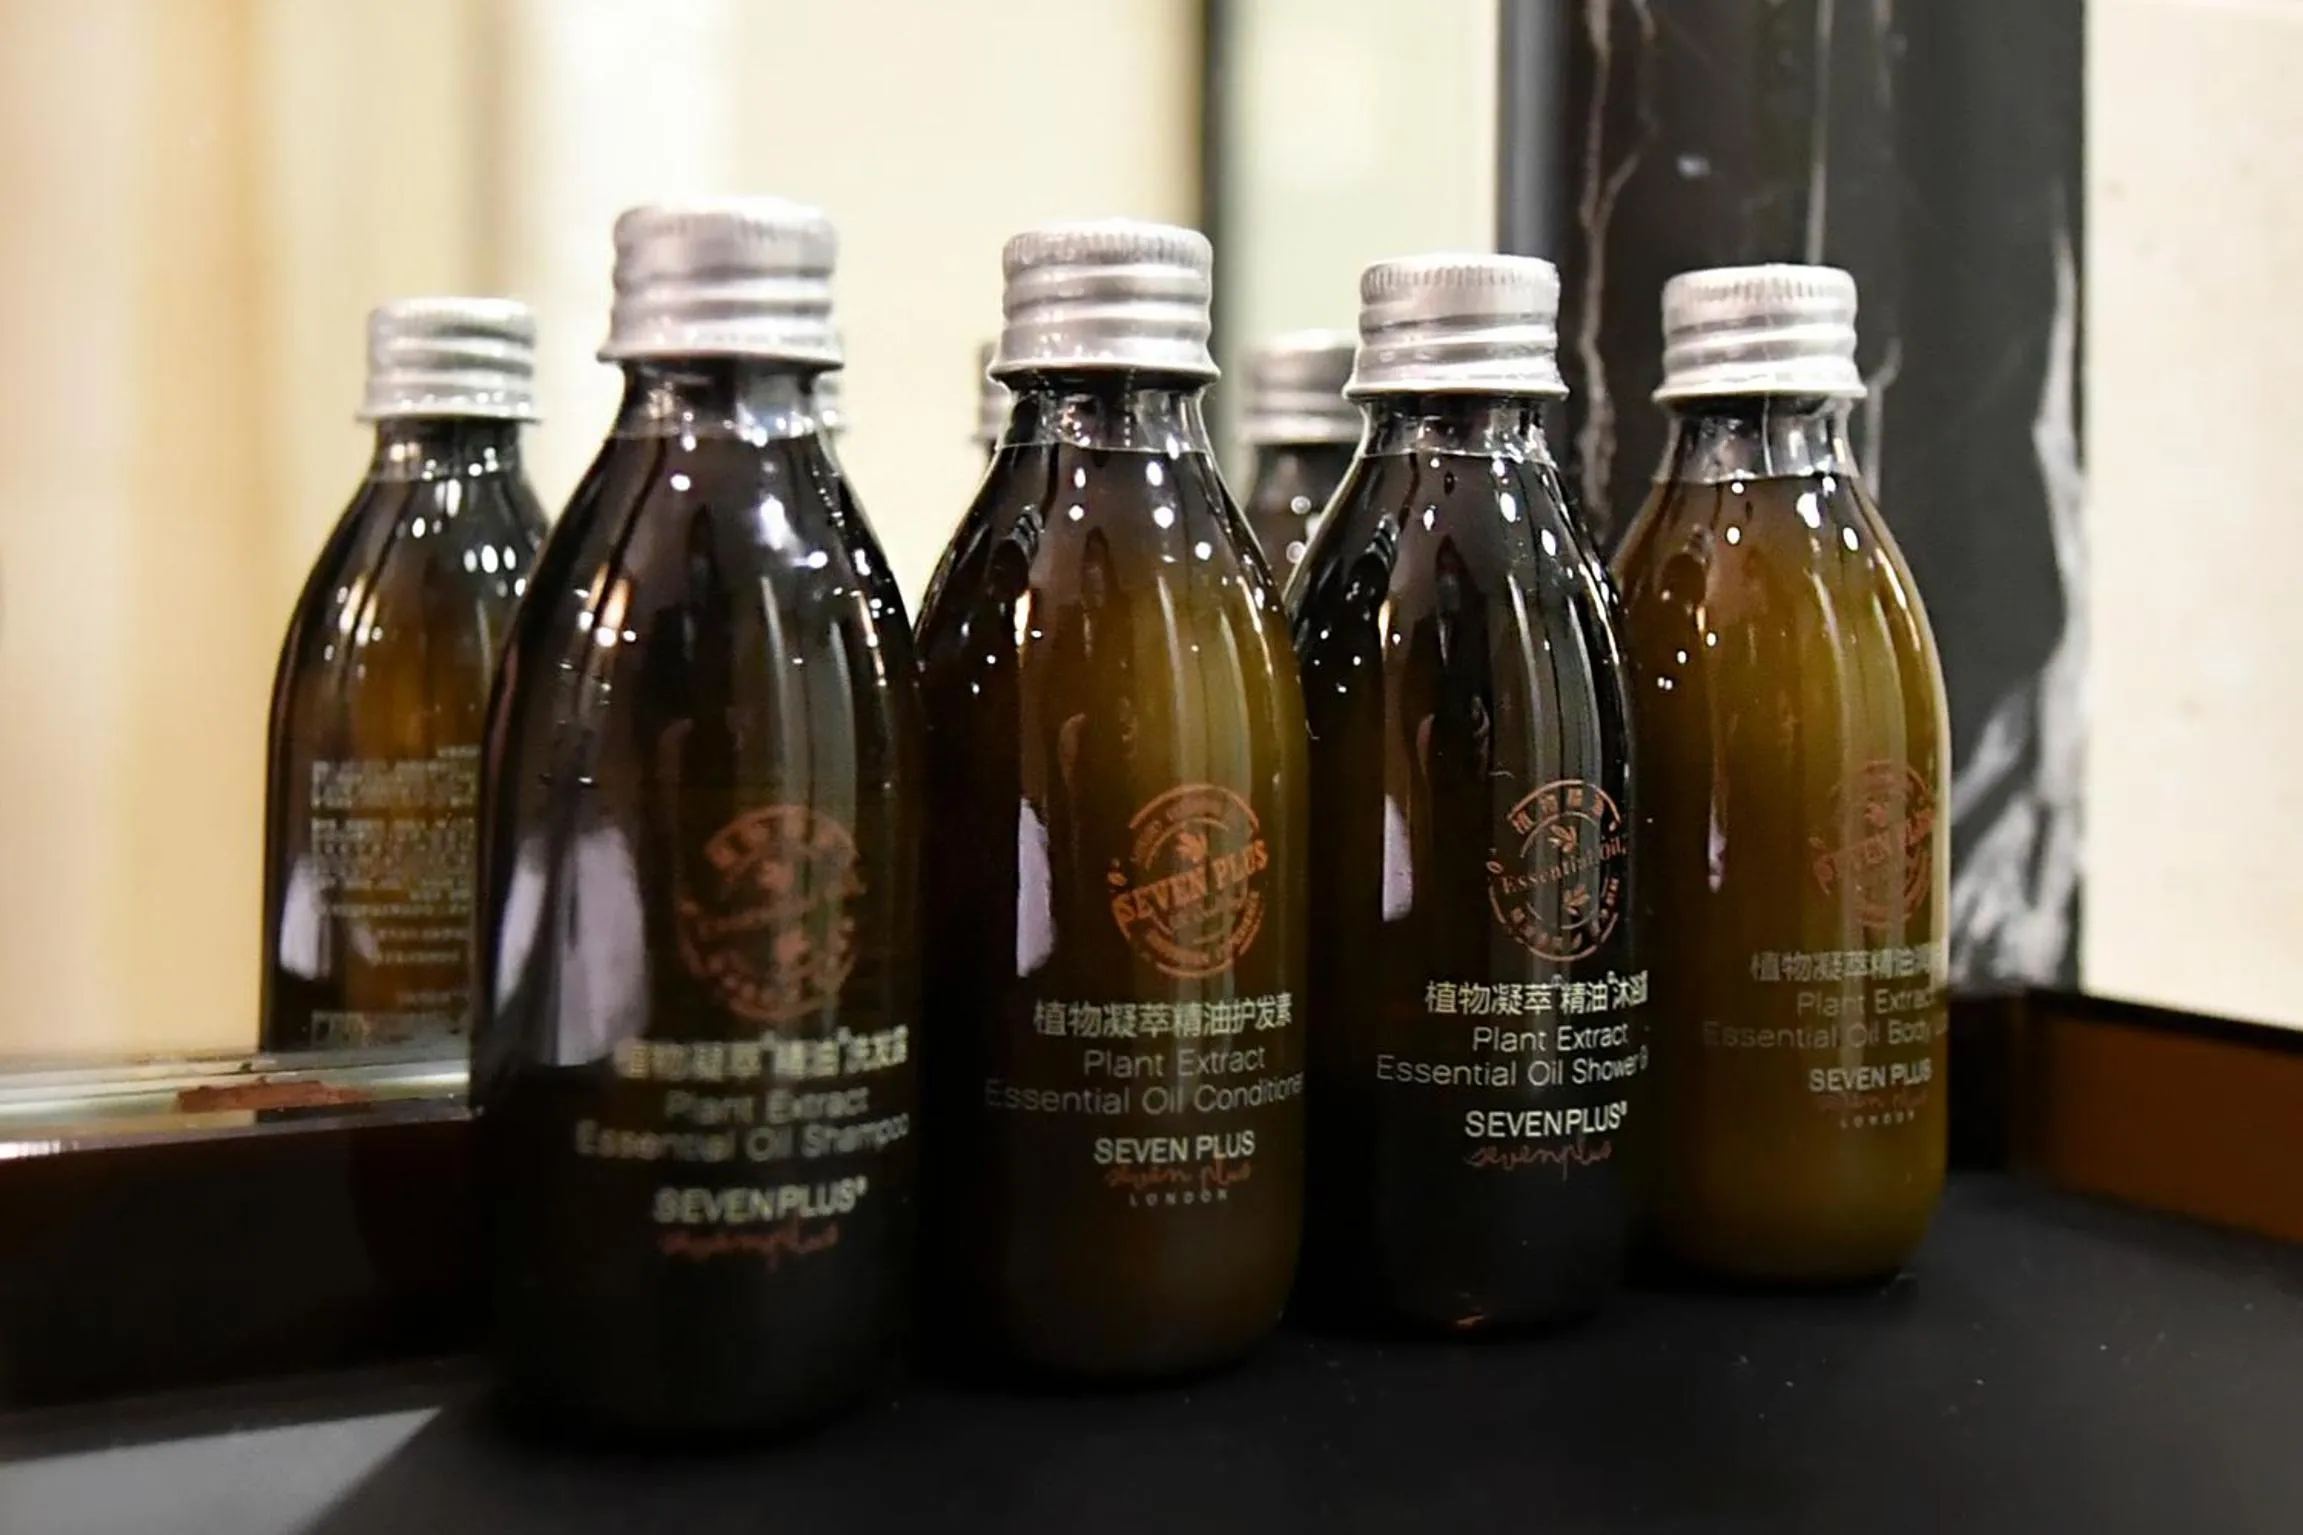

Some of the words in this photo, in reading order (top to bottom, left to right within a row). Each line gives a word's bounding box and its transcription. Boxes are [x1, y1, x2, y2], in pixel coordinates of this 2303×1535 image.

[1033, 993, 1292, 1038] 植物凝萃精油护发素
[1797, 991, 1865, 1017] Plant
[1473, 1026, 1547, 1052] Plant
[1557, 1023, 1628, 1051] Extract
[1703, 1020, 1837, 1049] Essential
[1849, 1023, 1879, 1049] Oil
[1083, 1050, 1165, 1078] Plant
[1177, 1047, 1265, 1077] Extract
[1376, 1054, 1517, 1086] Essential
[1528, 1059, 1563, 1086] Oil
[1571, 1053, 1639, 1084] Shower
[1809, 1065, 1886, 1092] SEVEN
[1891, 1058, 1932, 1085] PLUS
[664, 1089, 755, 1125] Plant
[766, 1086, 869, 1124] Extract
[985, 1078, 1131, 1115] Essential
[1142, 1086, 1183, 1115] Oil
[575, 1119, 737, 1161] Essential
[746, 1126, 793, 1161] Oil
[1094, 1136, 1188, 1165] SEVEN
[1196, 1130, 1256, 1160] PLUS
[1129, 1187, 1229, 1207] LONDON
